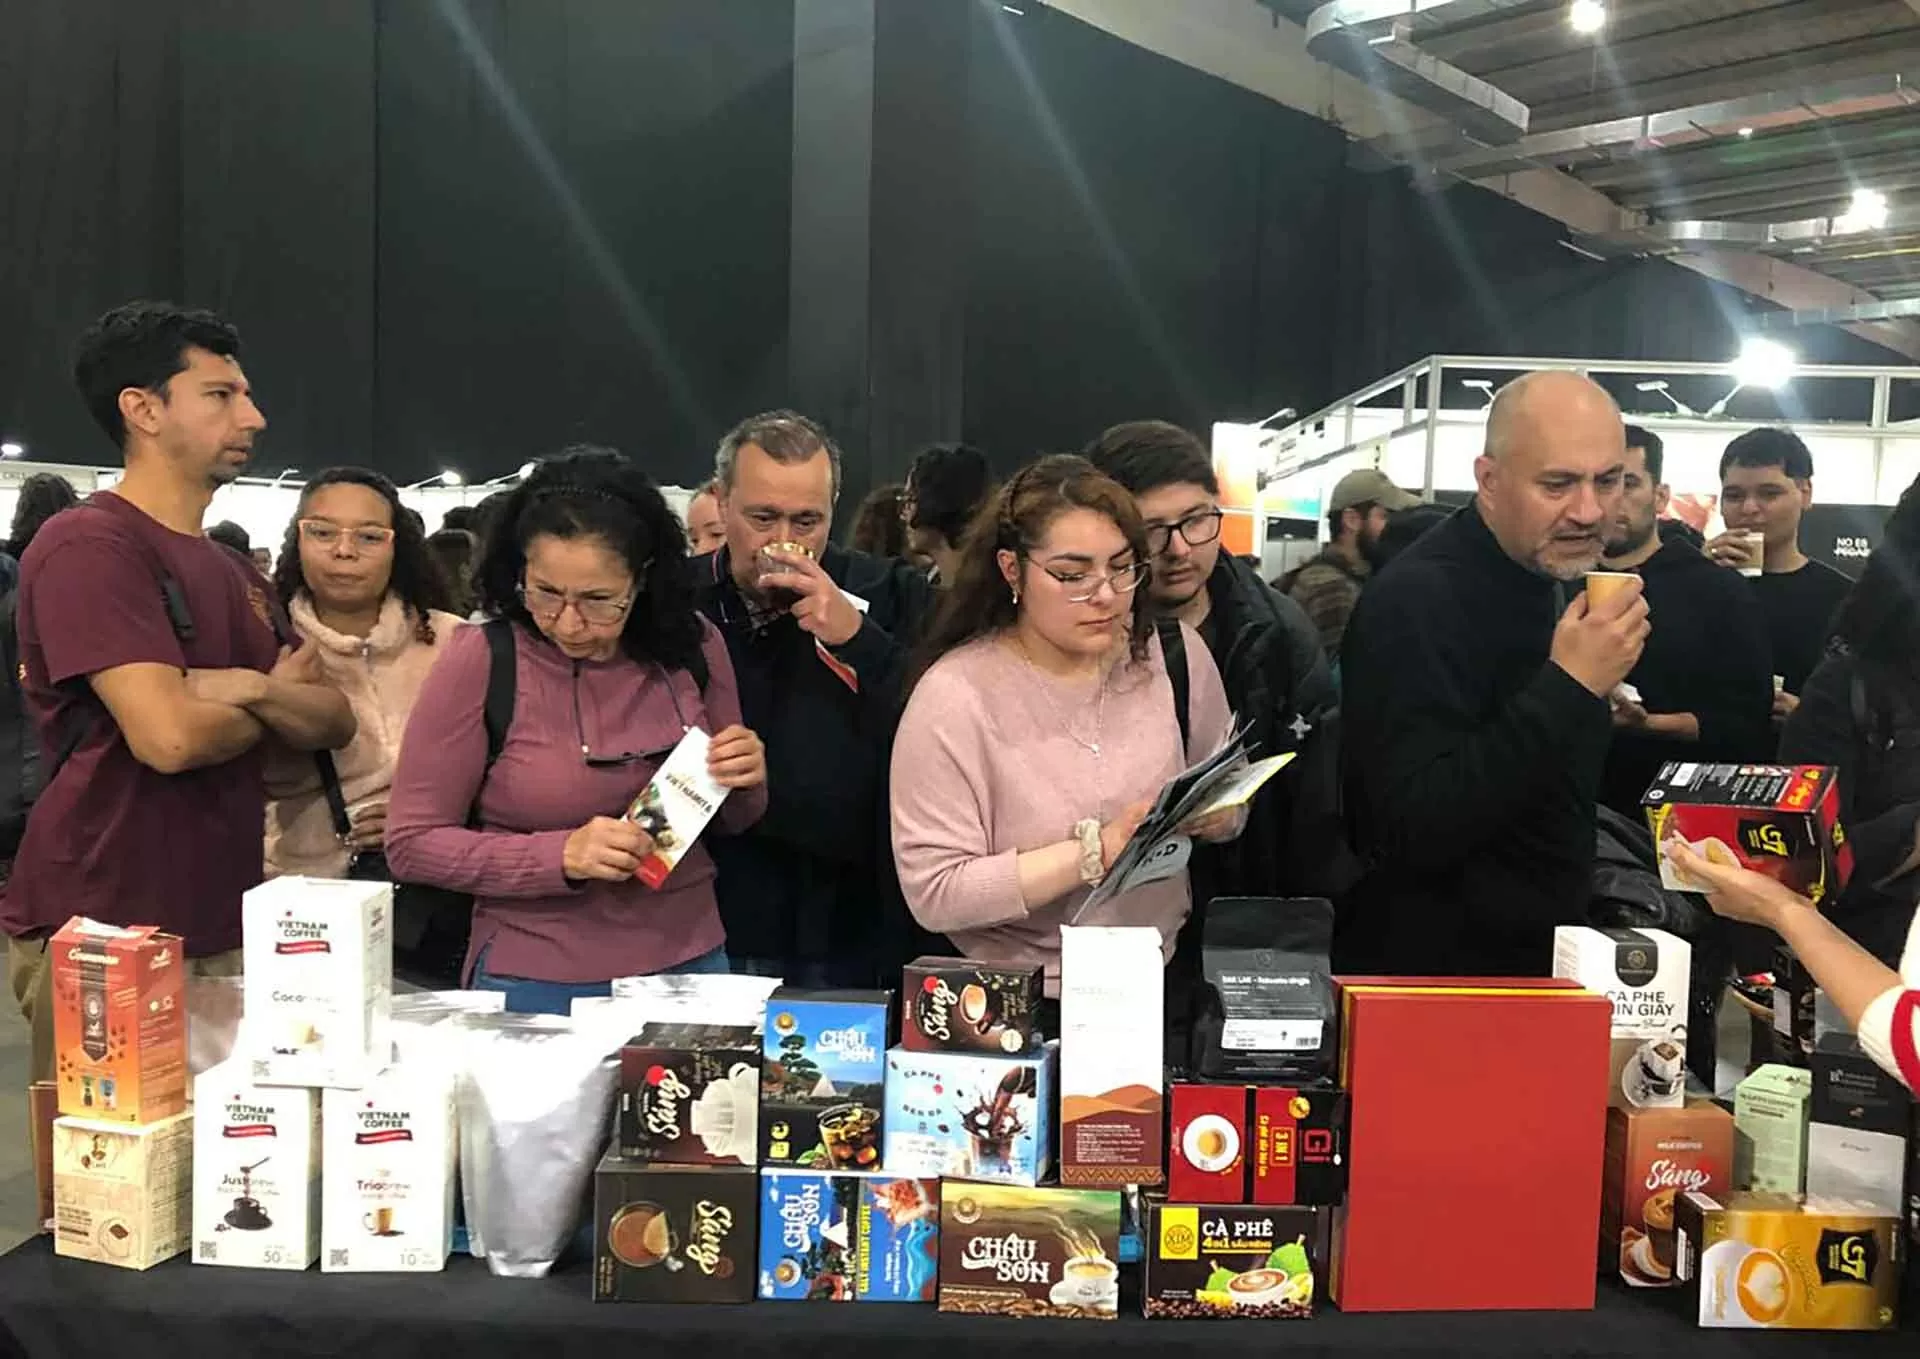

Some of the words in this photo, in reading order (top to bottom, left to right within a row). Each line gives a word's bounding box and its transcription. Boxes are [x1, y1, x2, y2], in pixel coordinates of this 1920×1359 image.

[1836, 537, 1853, 547] NO
[276, 919, 329, 931] VIETNAM
[283, 929, 322, 939] COFFEE
[225, 1103, 276, 1115] VIETNAM
[231, 1113, 268, 1123] COFFEE
[357, 1111, 411, 1121] VIETNAM
[363, 1119, 404, 1129] COFFEE
[1275, 1131, 1289, 1140] 3
[1645, 1159, 1711, 1191] Sáng
[1202, 1218, 1228, 1237] CÀ
[1234, 1218, 1274, 1236] PHÊ
